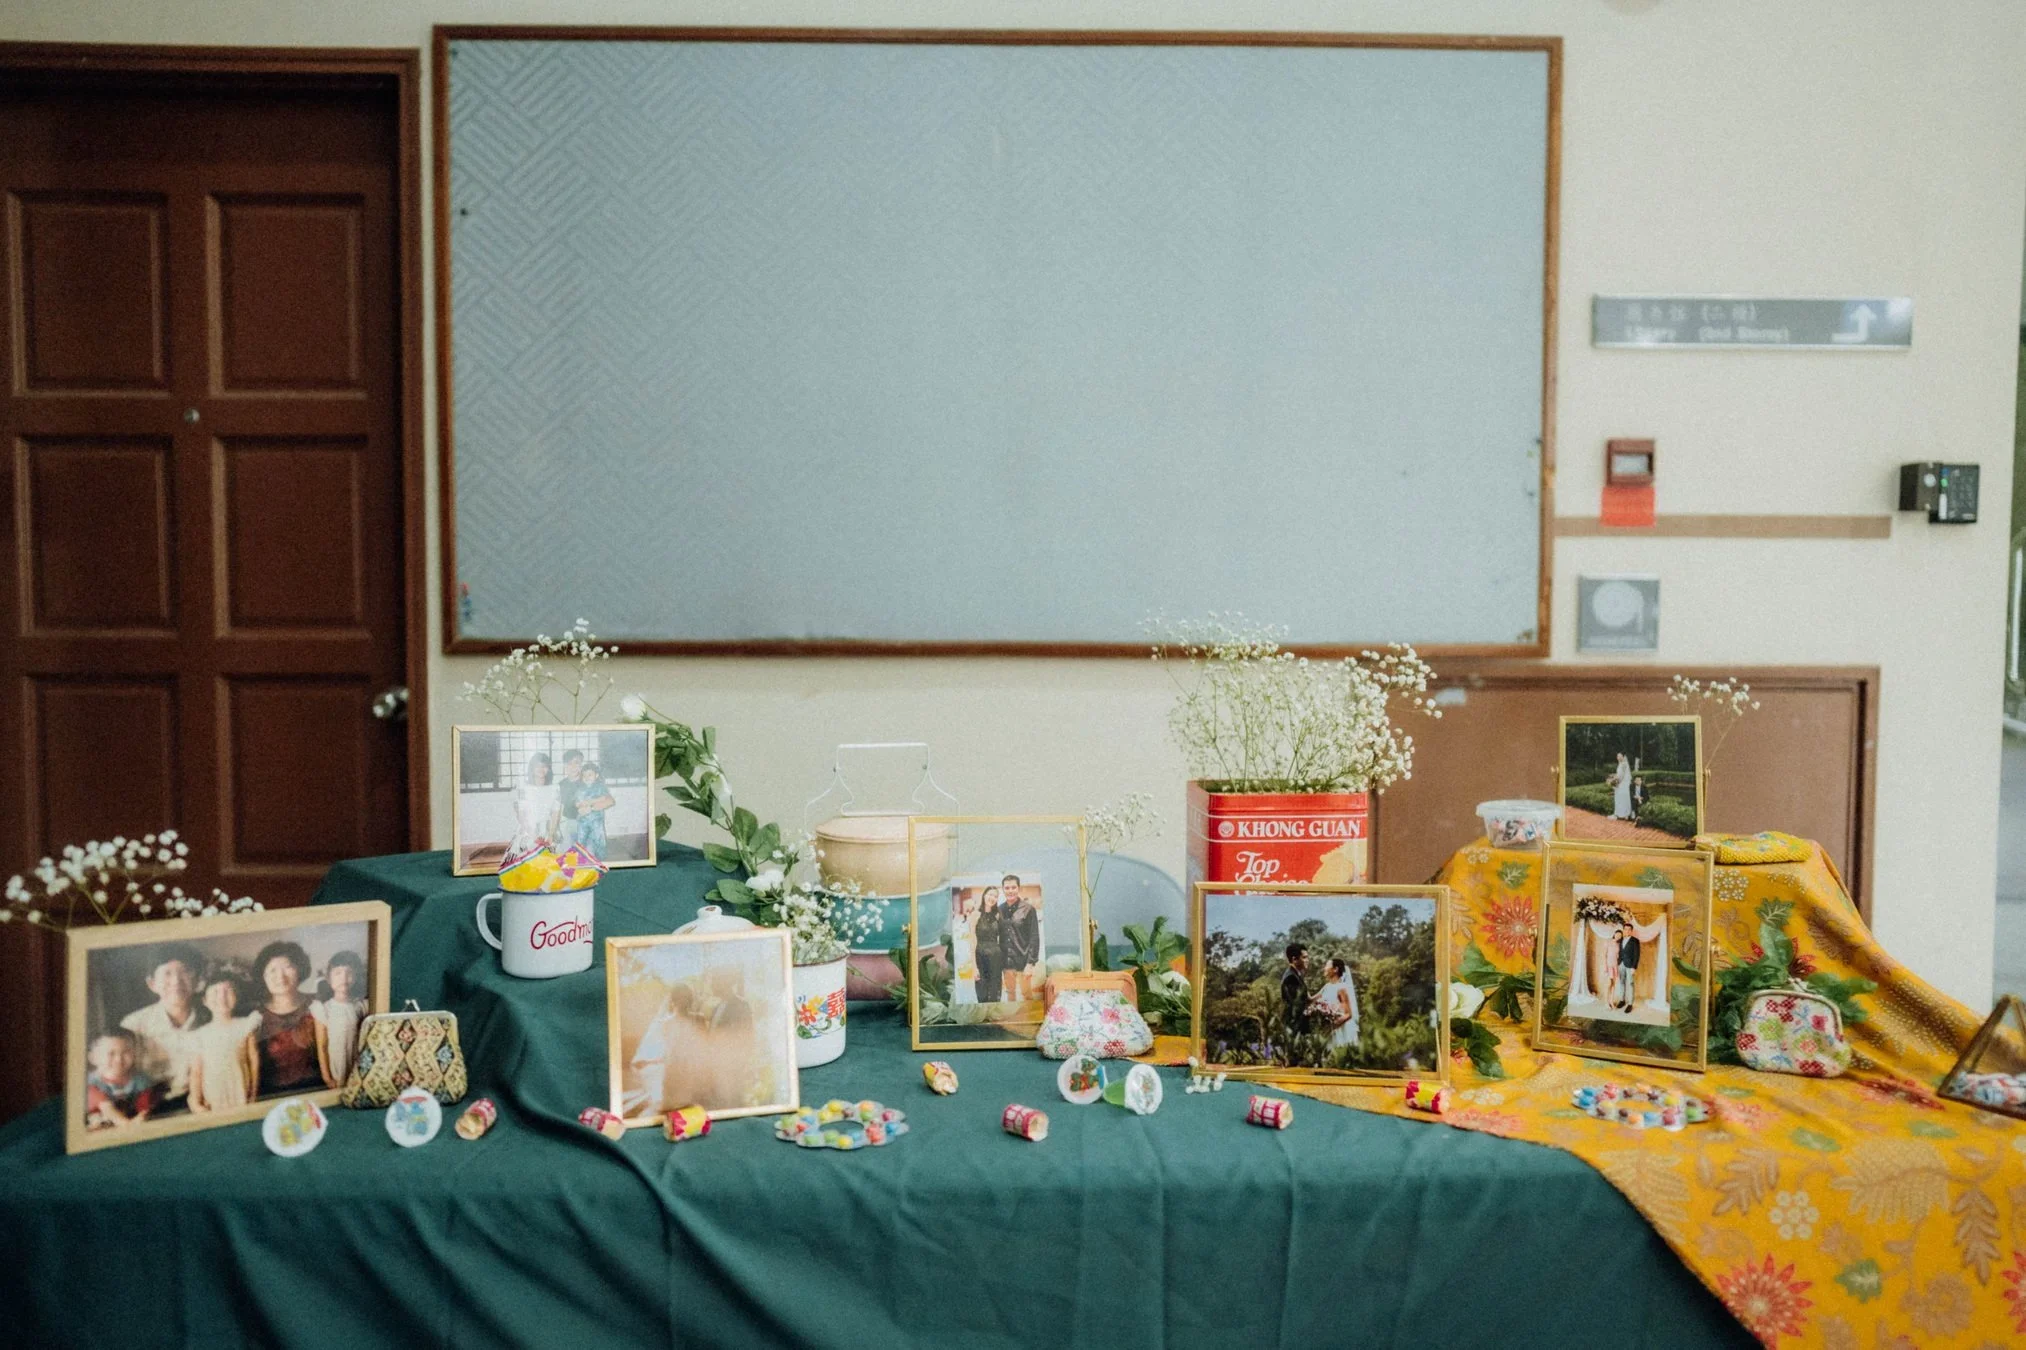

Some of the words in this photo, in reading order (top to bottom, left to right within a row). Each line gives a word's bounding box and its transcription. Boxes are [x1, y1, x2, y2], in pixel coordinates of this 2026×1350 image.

[1237, 821, 1305, 838] KHONG
[1309, 819, 1361, 838] GUAN
[1236, 850, 1280, 878] Top
